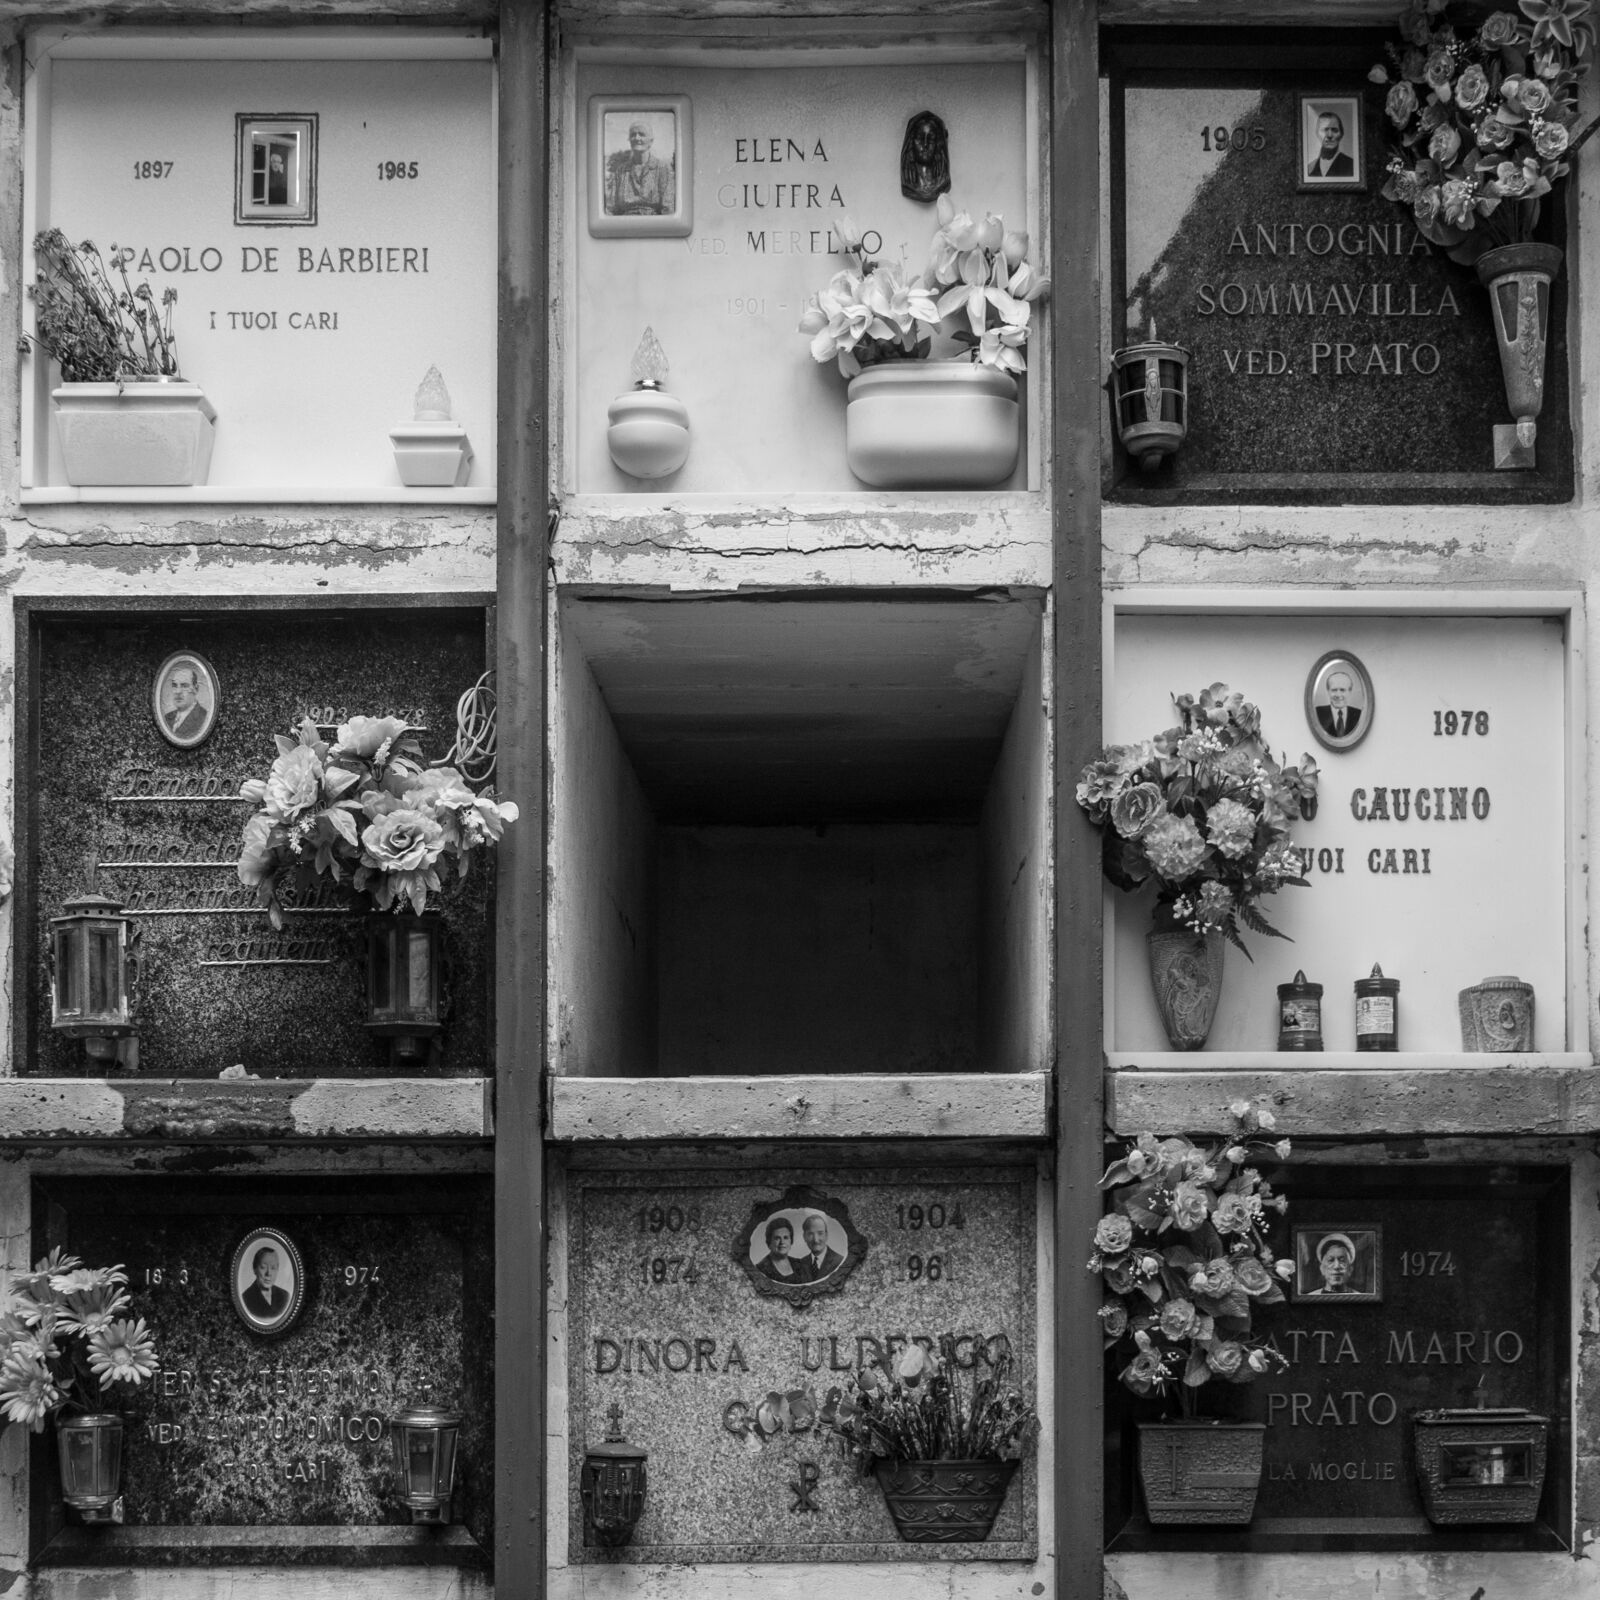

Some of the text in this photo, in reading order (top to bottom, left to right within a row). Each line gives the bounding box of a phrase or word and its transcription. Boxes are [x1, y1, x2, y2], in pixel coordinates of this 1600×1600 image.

[735, 137, 829, 163] ELENA
[1200, 125, 1266, 152] 1905
[133, 160, 175, 180] 1897
[376, 161, 420, 181] 1985
[717, 183, 846, 209] GIUFFRA
[746, 230, 884, 256] MERELO
[1226, 223, 1433, 256] ANTOGNIA
[119, 246, 431, 274] PAOLO DE BARBIERI
[727, 297, 767, 315] 1901
[1197, 282, 1462, 316] SOMMAVILLA
[209, 311, 339, 331] I TUOI CARI
[1224, 342, 1442, 376] VED. PRATO
[1433, 709, 1489, 737] 1978
[1350, 786, 1492, 822] CAUCINO
[1300, 847, 1432, 875] UOI CARI
[896, 1203, 967, 1231] 1904
[640, 1257, 700, 1285] 1974
[1400, 1251, 1456, 1277] 1974
[594, 1338, 750, 1374] DINORA
[1385, 1330, 1525, 1364] MARIO
[1267, 1392, 1398, 1426] PRATO
[1268, 1462, 1396, 1481] LA MOGLIE
